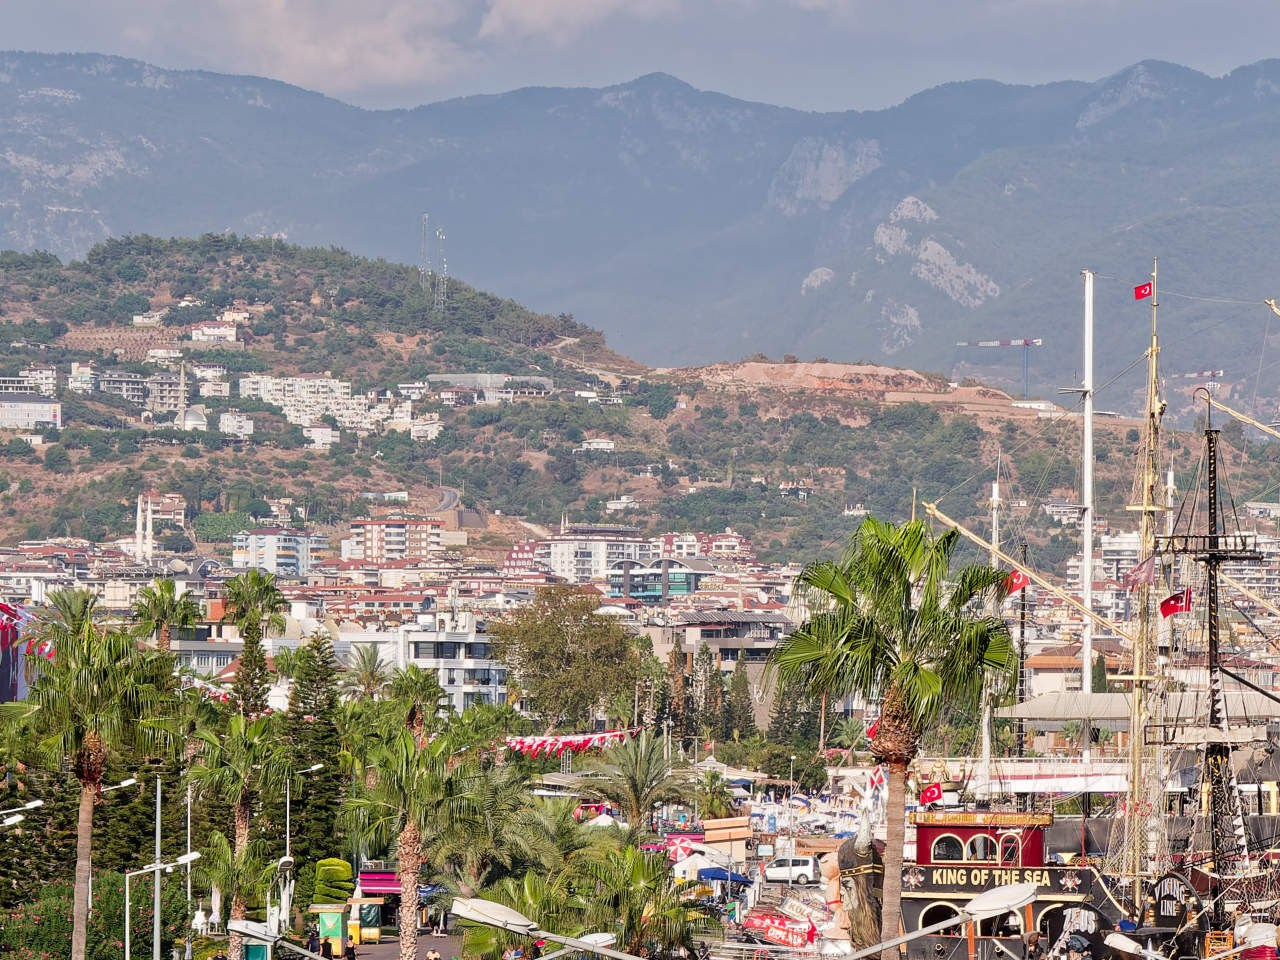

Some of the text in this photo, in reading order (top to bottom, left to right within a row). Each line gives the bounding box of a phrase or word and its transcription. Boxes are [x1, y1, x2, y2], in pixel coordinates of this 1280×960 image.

[932, 869, 1050, 887] KING OF THE SEA
[1160, 900, 1177, 916] LINE
